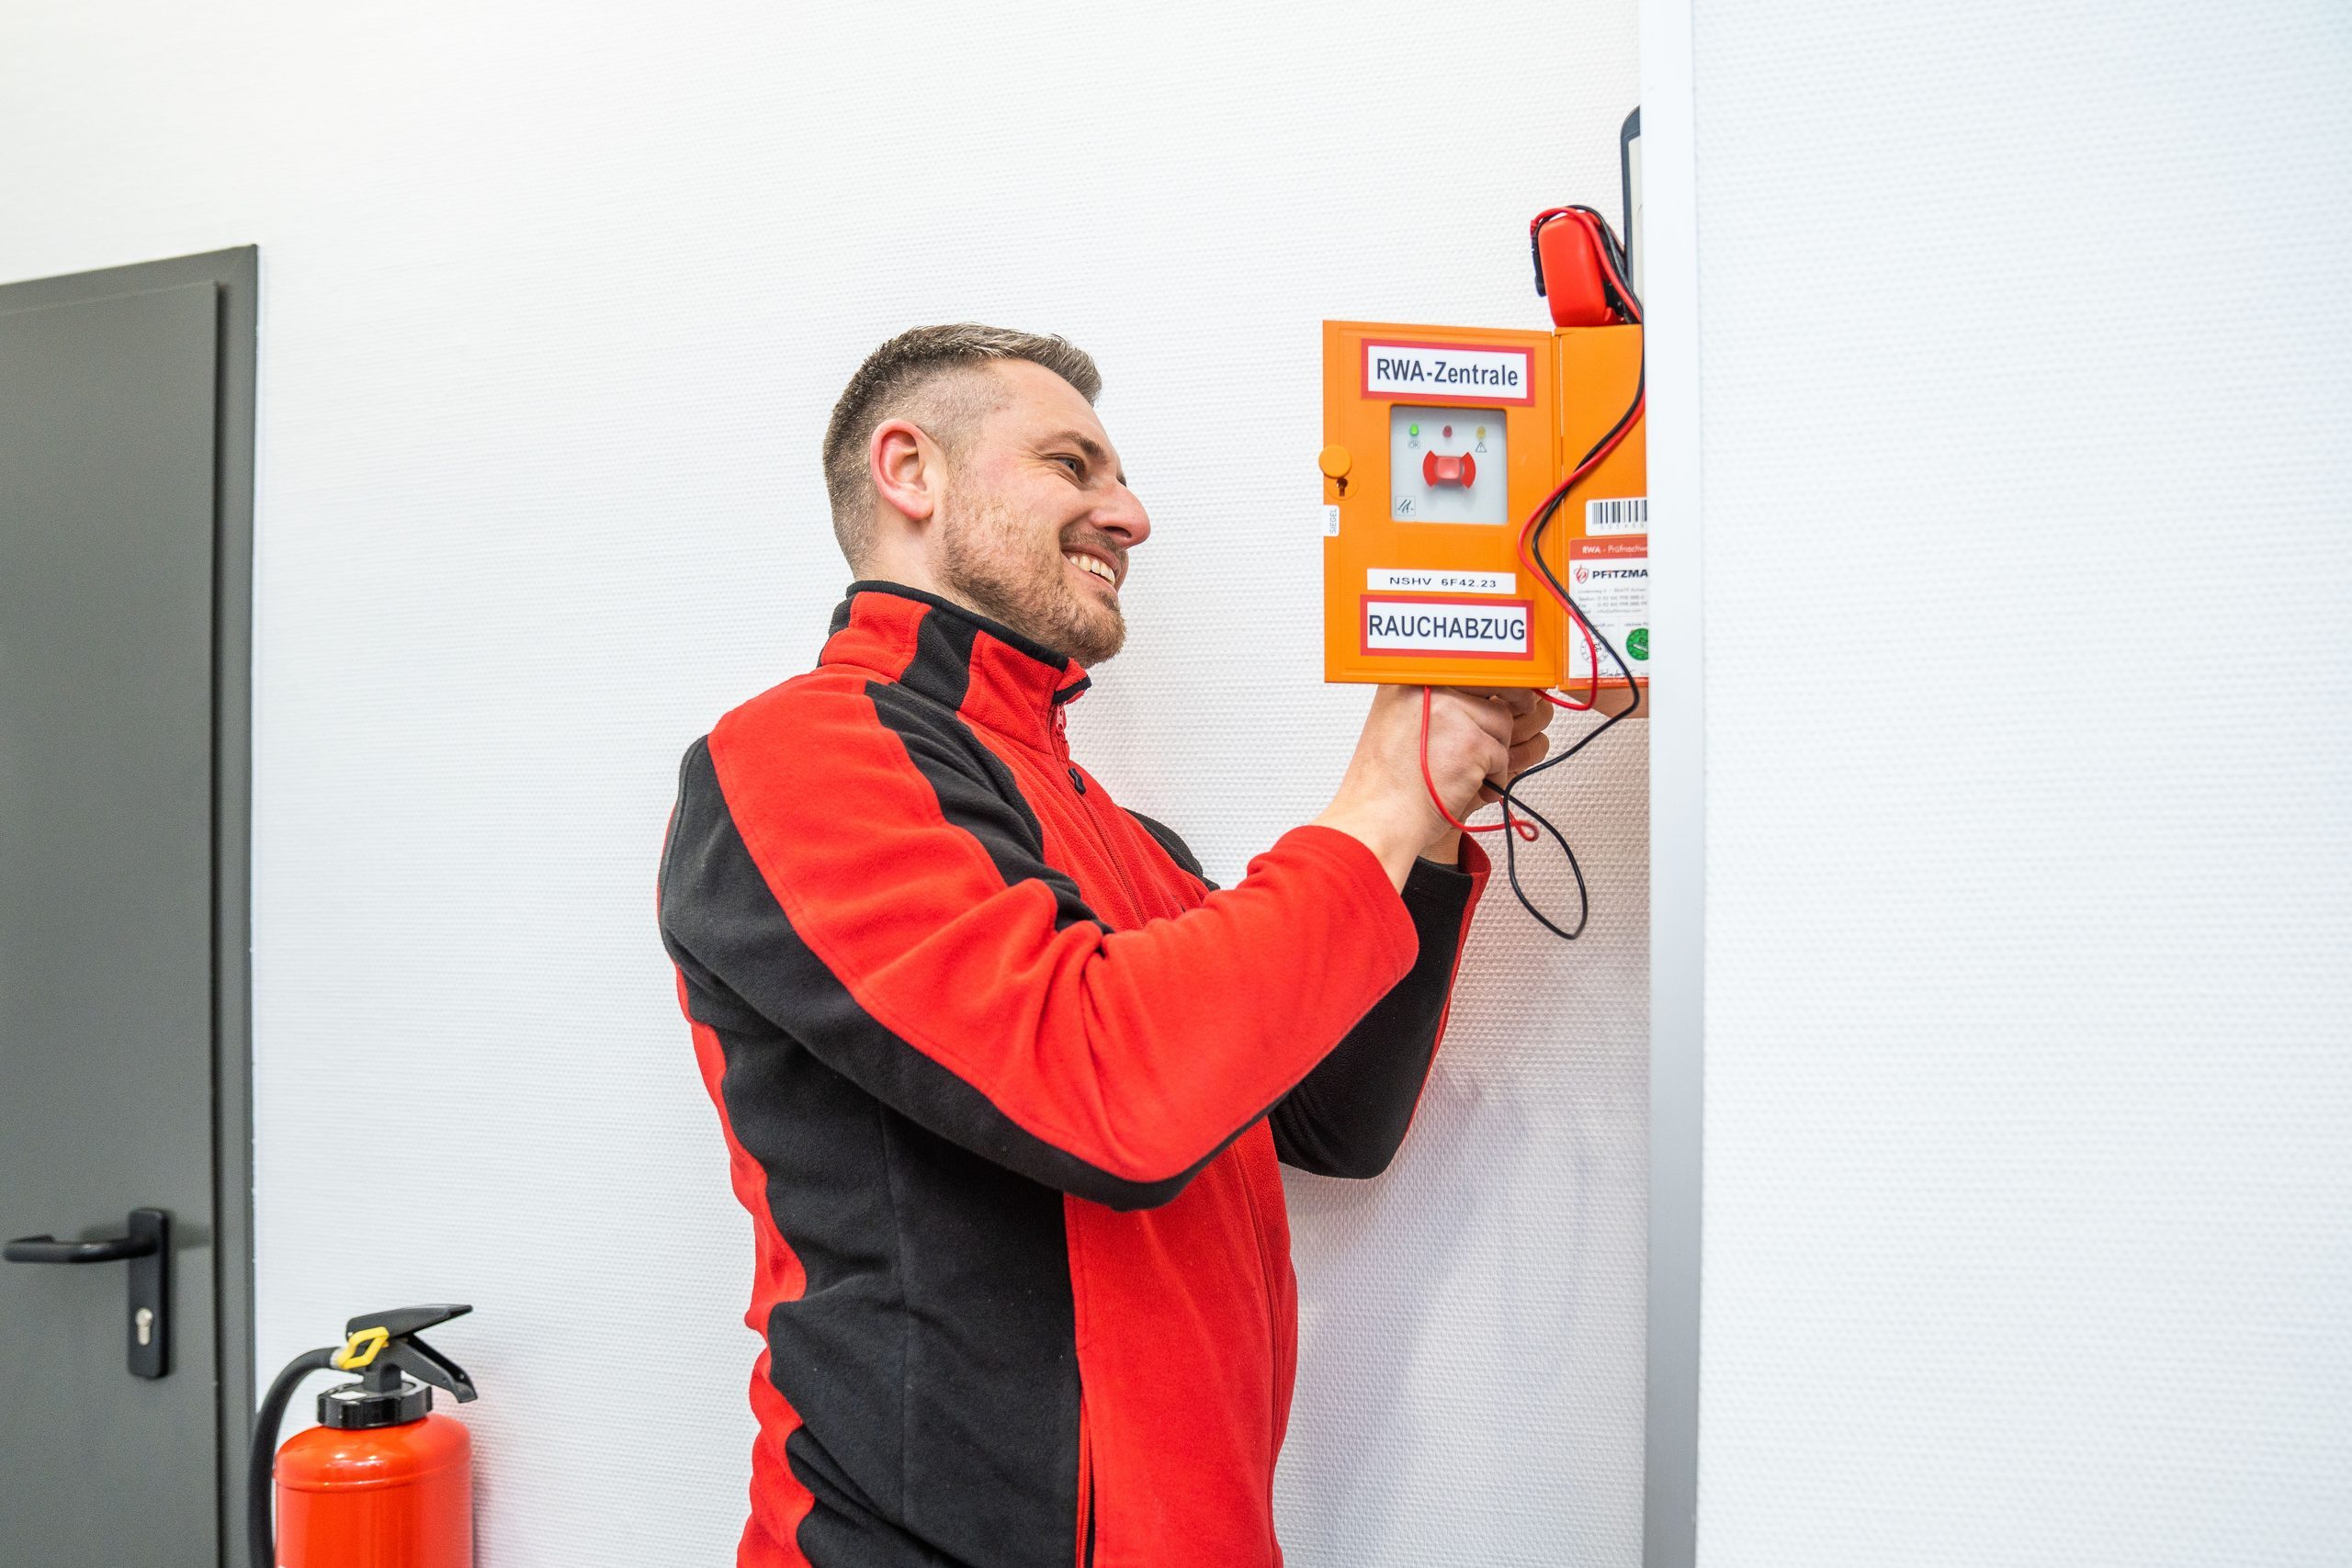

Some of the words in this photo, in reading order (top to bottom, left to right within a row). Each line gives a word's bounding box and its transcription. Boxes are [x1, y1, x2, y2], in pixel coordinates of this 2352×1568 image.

[1375, 357, 1519, 387] RWA-Zentrale
[1329, 508, 1338, 534] SIEGEL
[1582, 545, 1601, 554] RWA
[1389, 577, 1431, 586] NSHV
[1441, 578, 1497, 588] 6F42.23
[1369, 615, 1525, 641] RAUCHABZUG
